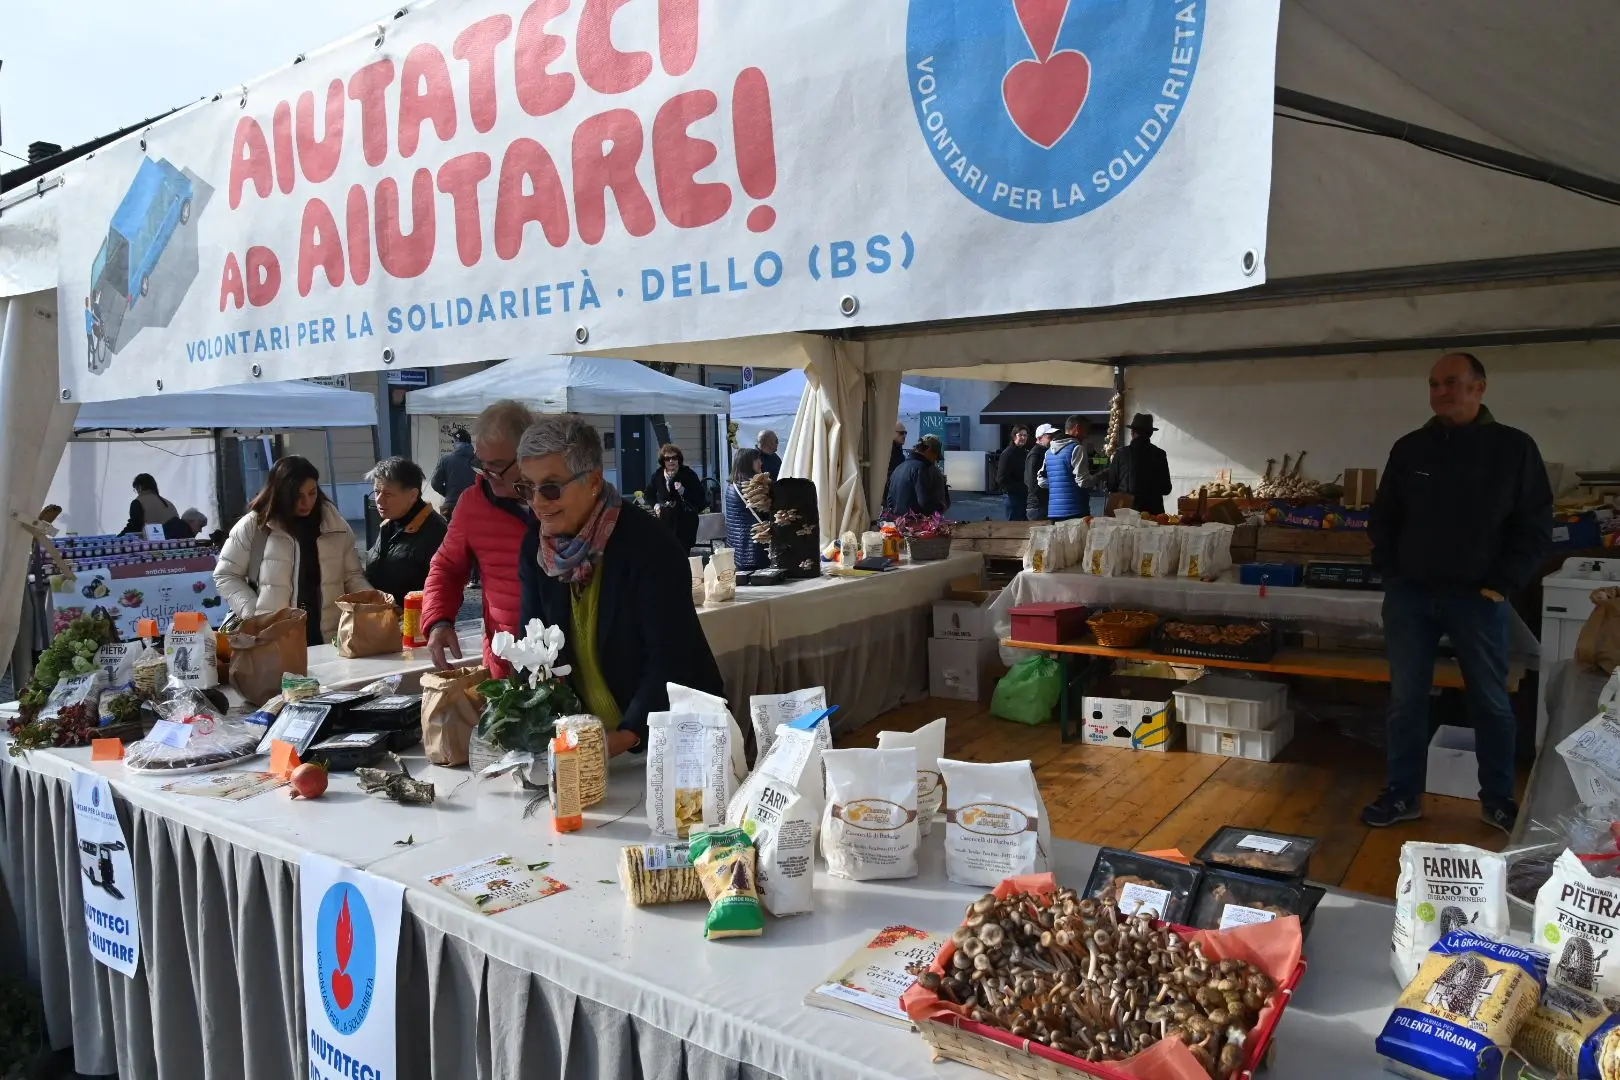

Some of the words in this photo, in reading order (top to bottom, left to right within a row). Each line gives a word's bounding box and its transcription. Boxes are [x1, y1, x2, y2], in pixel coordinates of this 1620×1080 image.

[229, 0, 698, 210] AIUTATECI
[915, 55, 987, 194] VOLONTARI
[993, 181, 1041, 210] PER
[1052, 183, 1086, 209] LA
[220, 245, 281, 312] AD
[298, 67, 777, 297] AIUTARE!
[186, 323, 292, 363] VOLONTARI
[297, 319, 336, 347] PER
[347, 312, 373, 339] LA
[387, 269, 601, 334] SOLIDARIETÀ
[642, 250, 783, 302] DELLO
[809, 231, 915, 281] (BS)
[1345, 517, 1368, 529] Auro
[1423, 856, 1483, 880] FARINA
[1428, 884, 1461, 896] TIPO
[1457, 895, 1487, 903] TENERO
[1556, 911, 1614, 940] FARRO
[1558, 923, 1608, 945] INTEGRALE
[92, 932, 134, 964] AIUTARE
[911, 947, 936, 958] FUN
[1447, 936, 1460, 948] LA
[1461, 936, 1497, 953] GRANDE
[1499, 944, 1530, 962] RUOTA
[317, 950, 331, 1013] VOLONTARI
[328, 1011, 340, 1029] PER
[866, 971, 911, 988] OTTOBR
[1430, 1007, 1441, 1015] DAL
[1394, 1015, 1432, 1035] POLENTA
[1434, 1027, 1477, 1052] TARAGNA
[1421, 1016, 1442, 1028] FARINA
[1443, 1023, 1455, 1032] PER
